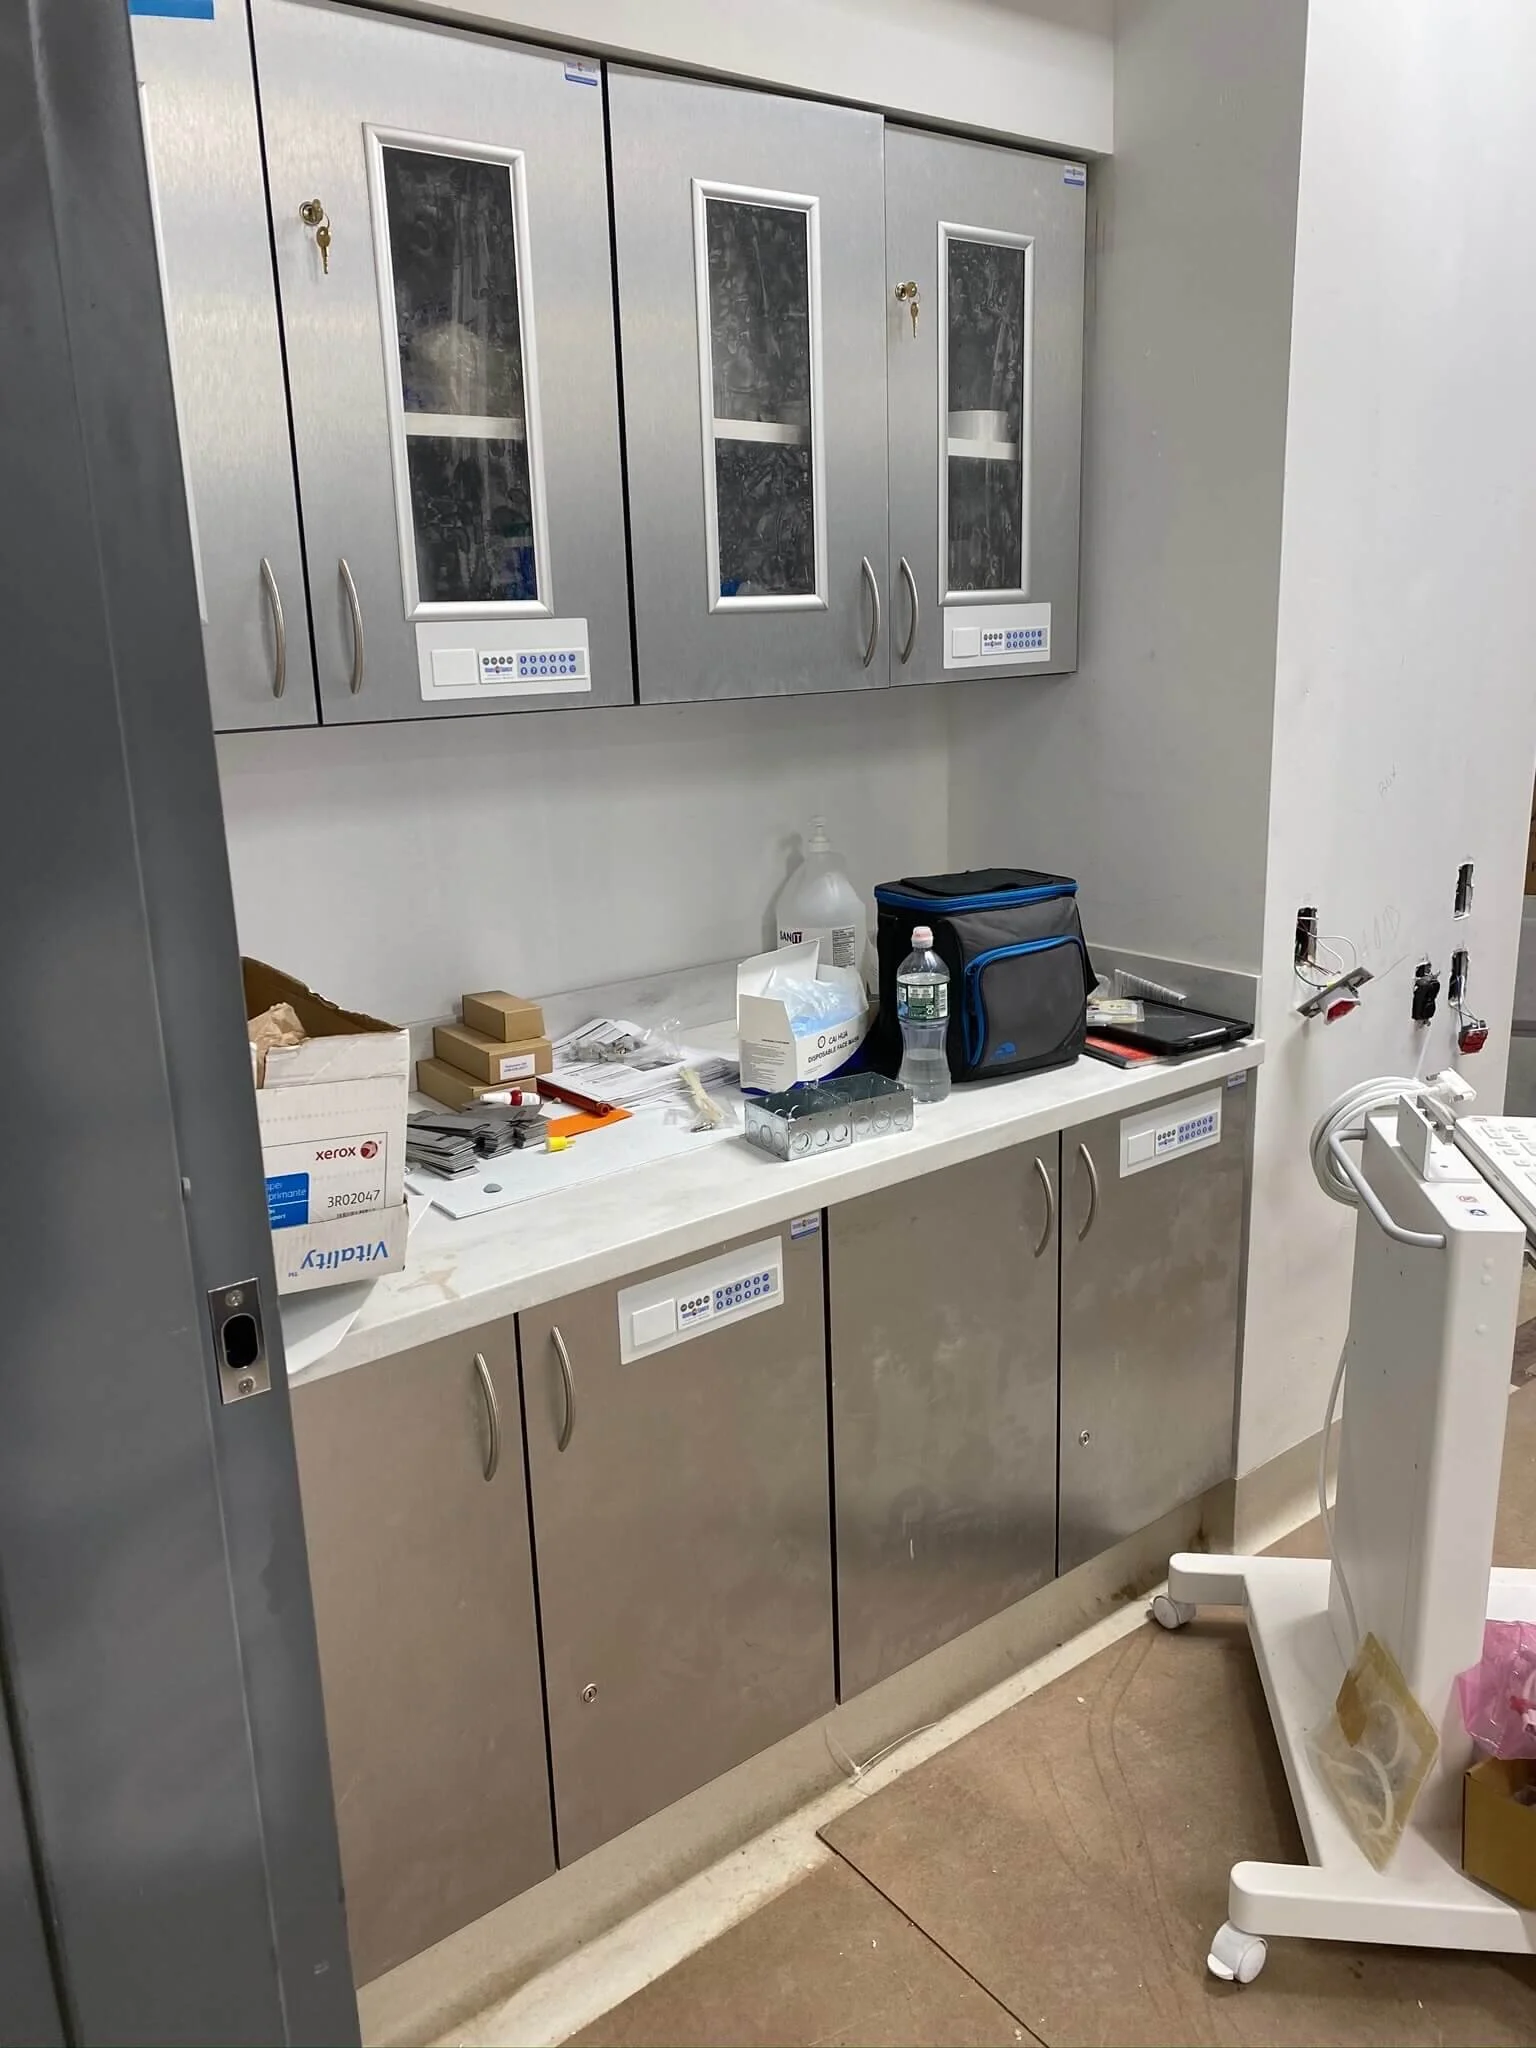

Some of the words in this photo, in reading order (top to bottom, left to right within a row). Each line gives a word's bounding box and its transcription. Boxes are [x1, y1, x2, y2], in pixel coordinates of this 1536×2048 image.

[315, 1146, 357, 1161] xerox
[327, 1190, 381, 1208] 3R02047
[300, 1241, 389, 1270] Vitality
